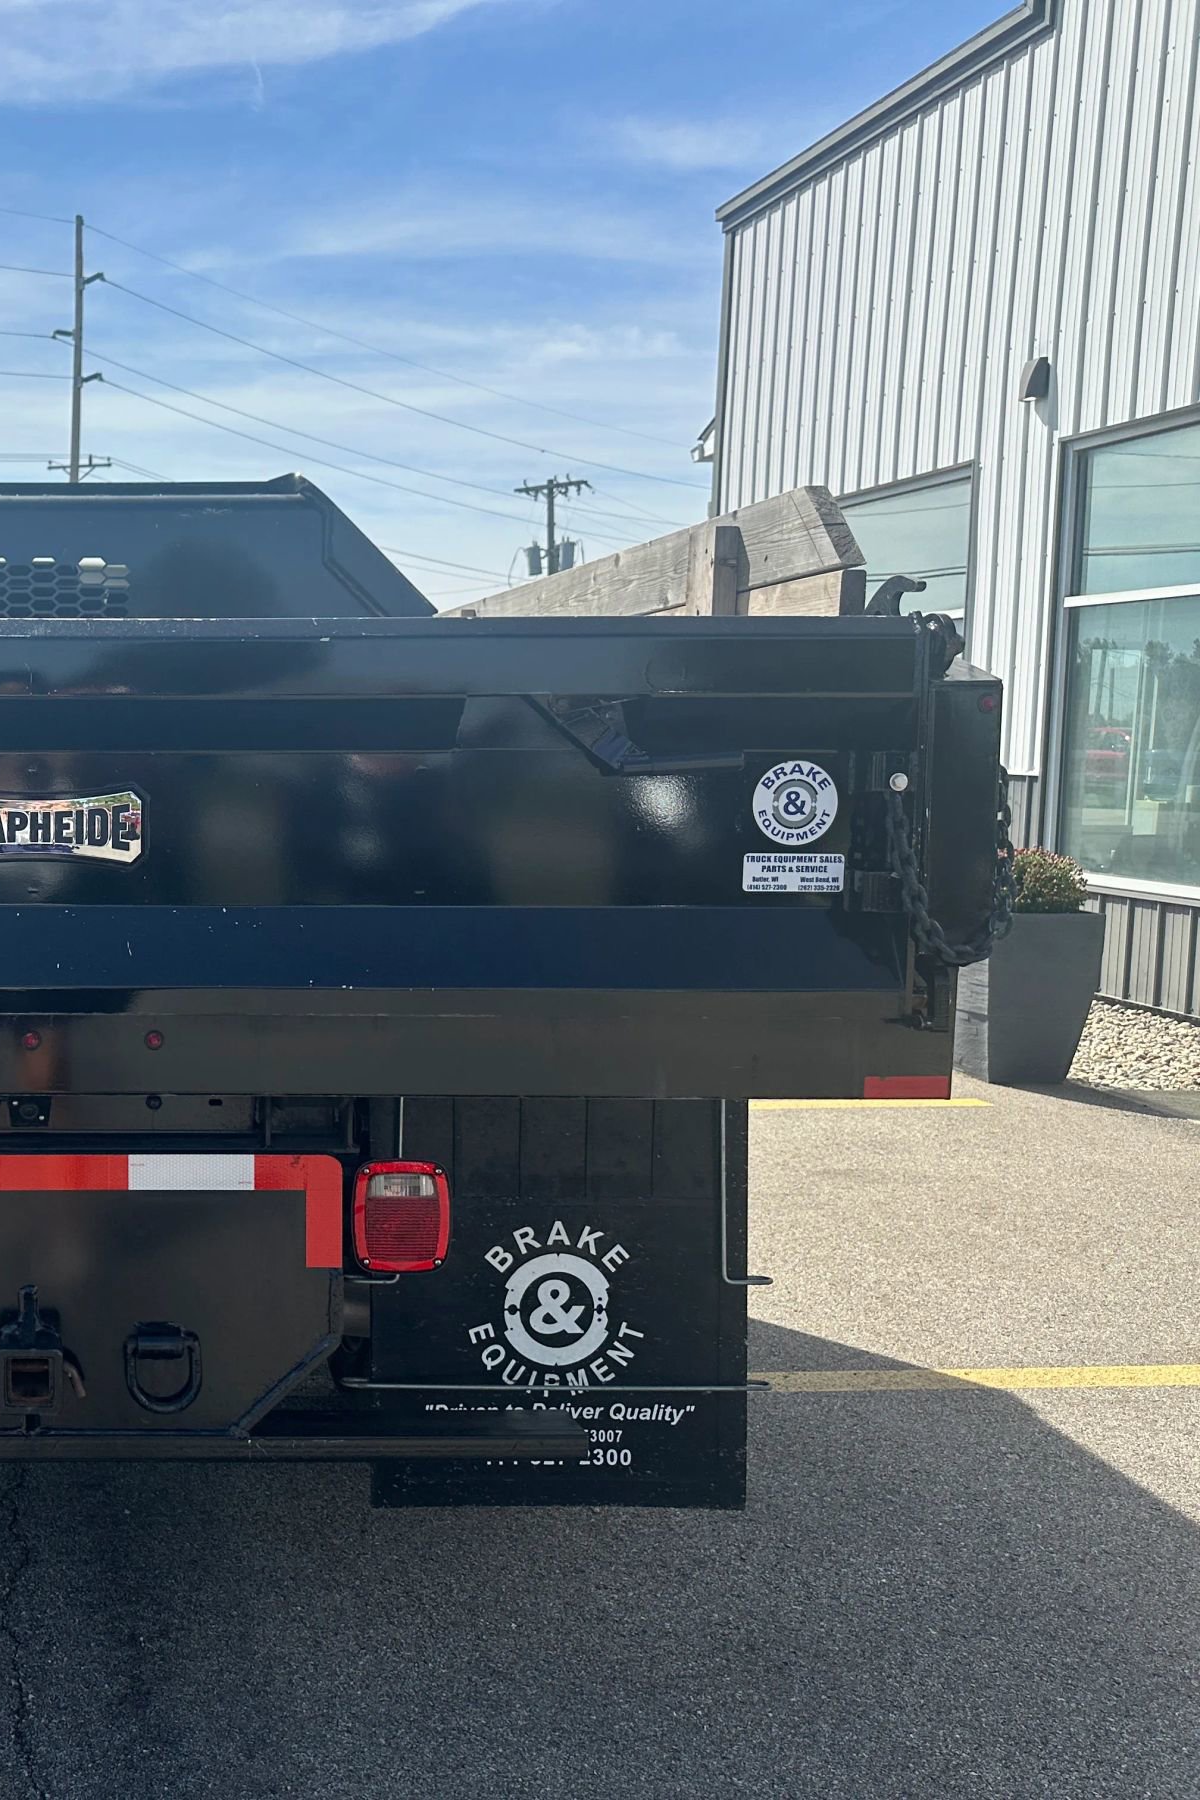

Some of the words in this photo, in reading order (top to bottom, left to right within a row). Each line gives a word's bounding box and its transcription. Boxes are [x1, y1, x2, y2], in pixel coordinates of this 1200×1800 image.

[761, 763, 831, 791] BRAKE
[783, 791, 806, 815] &
[758, 809, 831, 841] EQUIPMENT
[746, 855, 772, 863] TRUCK
[773, 855, 818, 863] EQUIPMENT
[761, 865, 786, 873] PARTS
[795, 865, 828, 873] SERVICE
[484, 1220, 630, 1273] BRAKE
[529, 1279, 585, 1335] &
[468, 1321, 645, 1398] EQUIPMENT
[609, 1403, 695, 1425] Quality"
[583, 1429, 623, 1442] 3007
